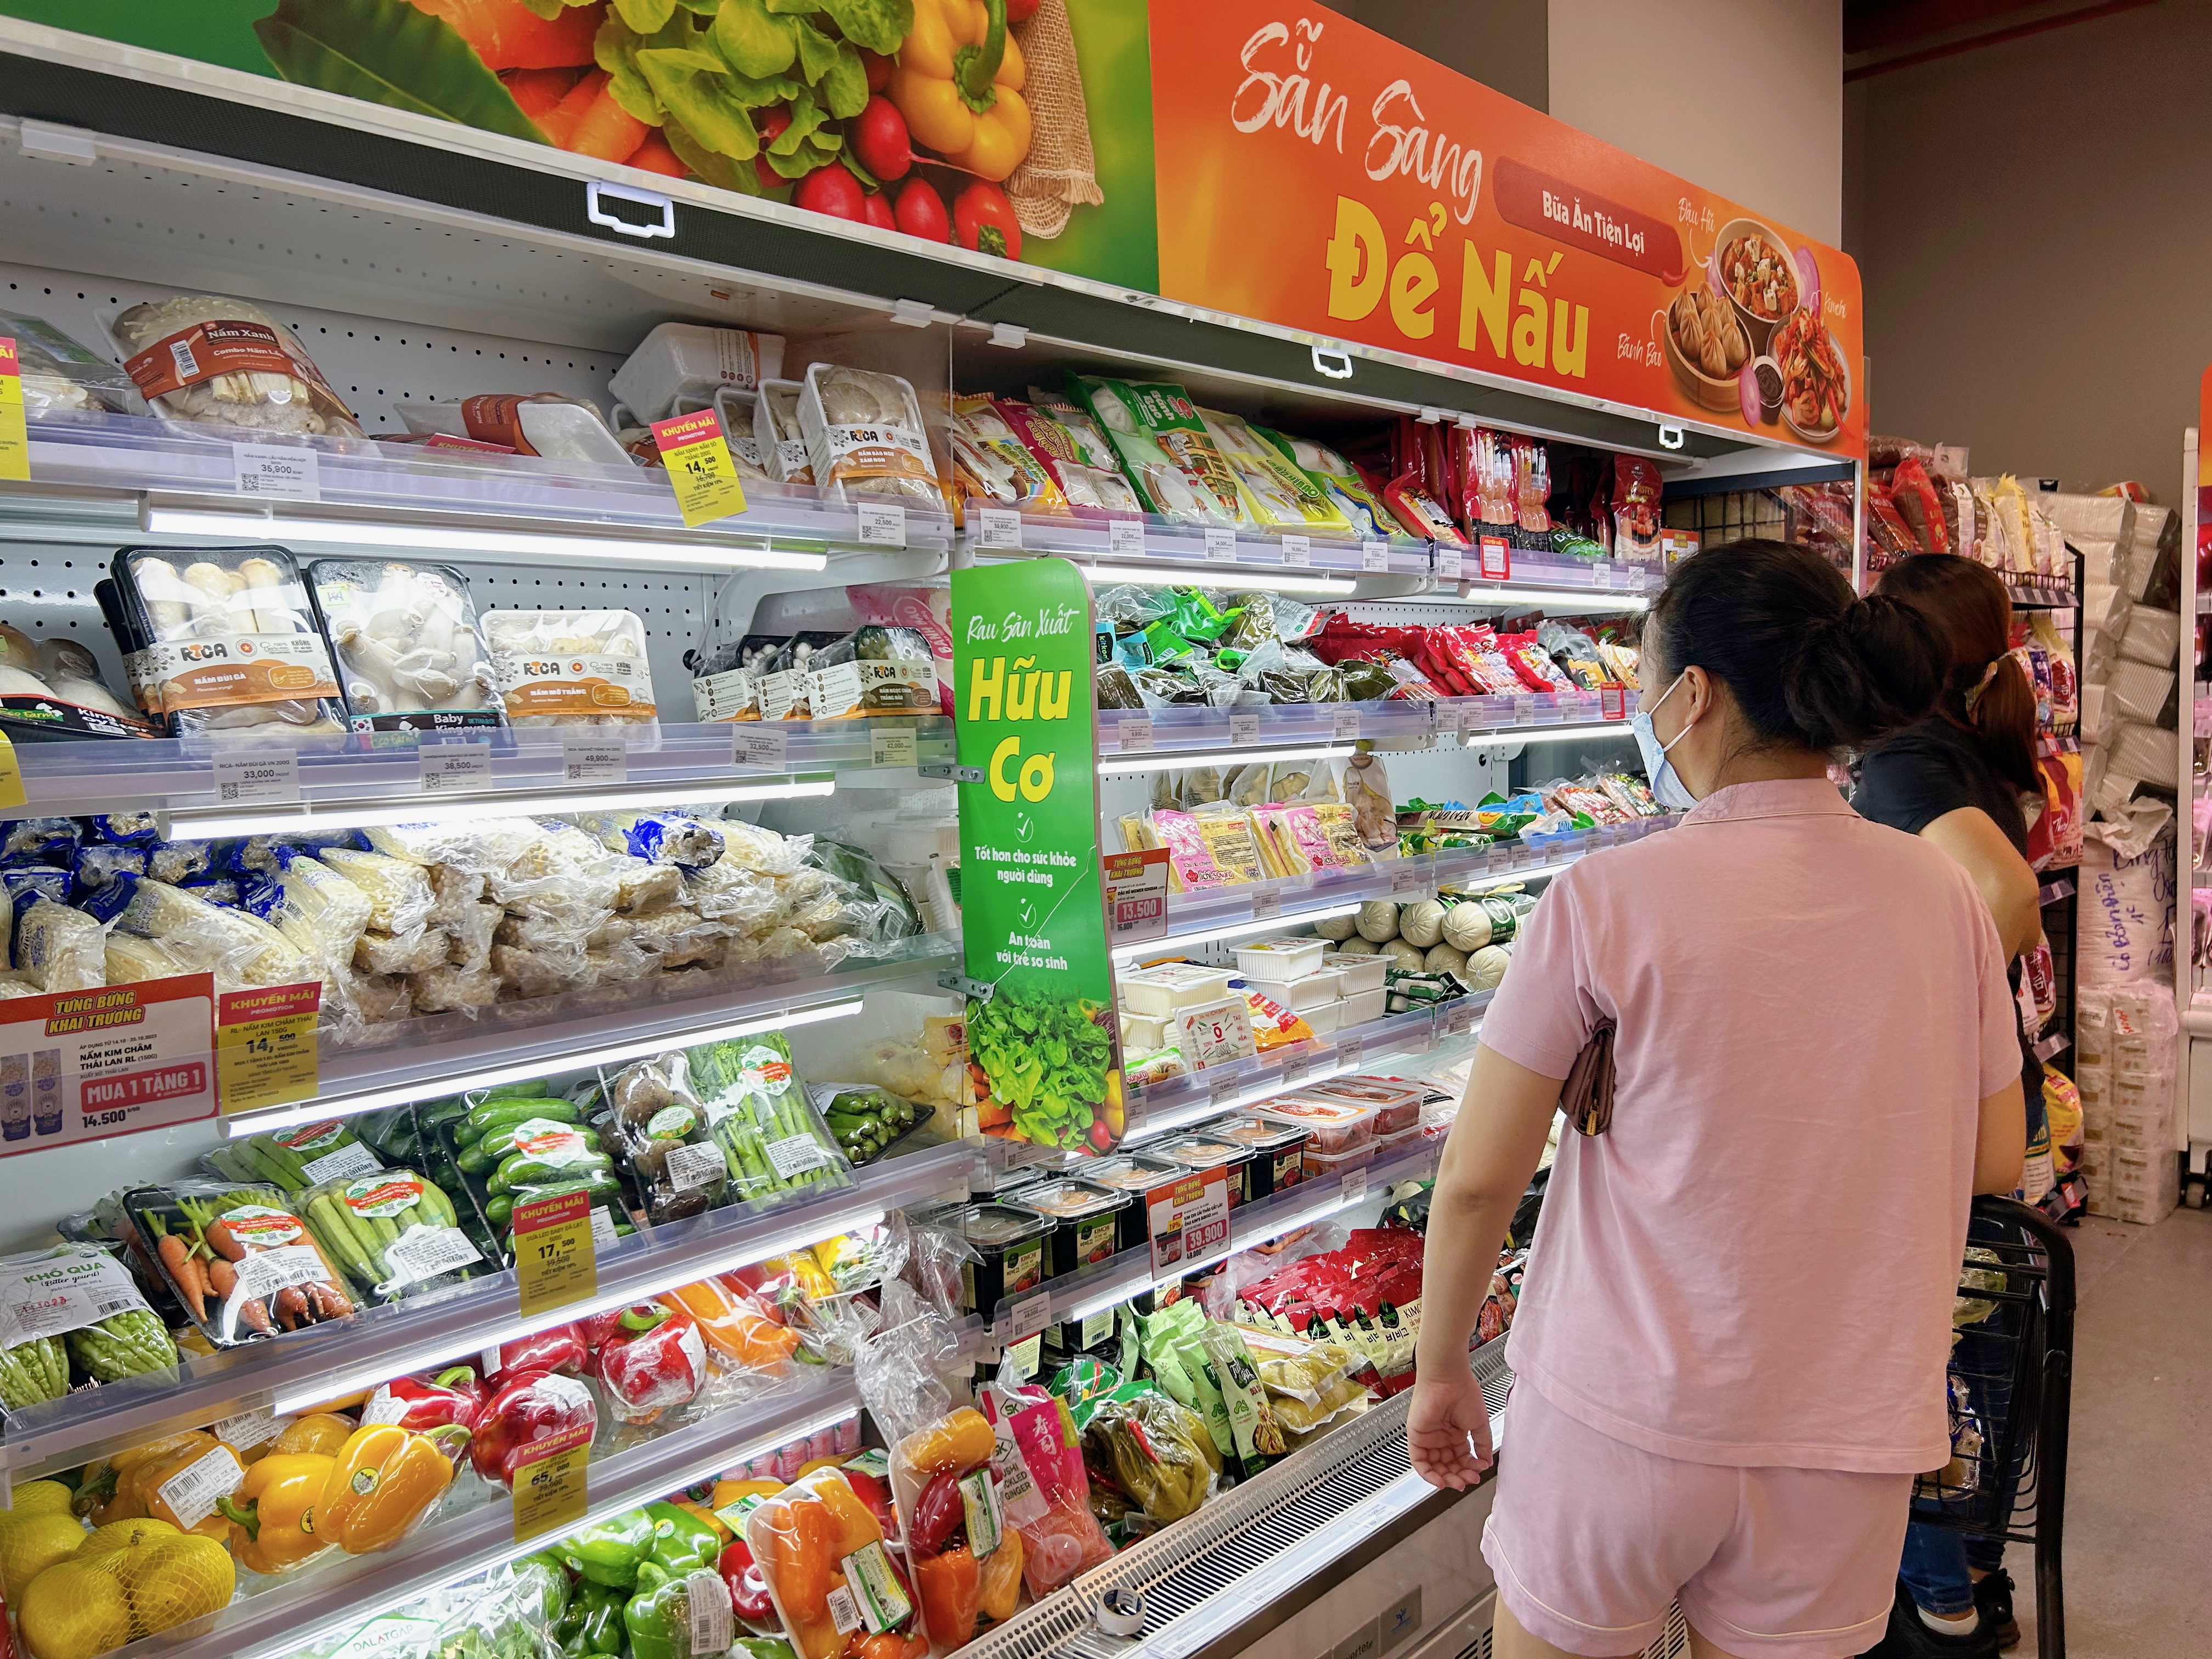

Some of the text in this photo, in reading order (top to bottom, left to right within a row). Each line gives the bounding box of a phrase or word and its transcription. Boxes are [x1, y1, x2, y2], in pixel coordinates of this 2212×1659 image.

[1232, 18, 1482, 224] Sẵn Sàng
[1542, 190, 1645, 255] Bữa Ăn Tiện Lợi
[1326, 194, 1589, 379] Để Nấu
[207, 328, 275, 342] Nấm Xanh
[1143, 396, 1163, 420] Bao
[1150, 390, 1175, 421] Bánh
[661, 416, 715, 437] KHUYẾN MÃI
[677, 430, 707, 442] PROMOTION
[849, 429, 879, 443] RICA
[261, 464, 292, 474] 35,900
[685, 456, 716, 475] 14, 500
[967, 602, 1080, 644] Rau Sản Xuất
[180, 642, 229, 662] RICA
[194, 671, 247, 685] NẤM ĐÙI GÀ
[523, 661, 561, 676] RICA
[873, 665, 896, 679] RICA
[530, 688, 550, 697] NẤM
[561, 686, 587, 696] TRẮNG
[968, 654, 1073, 723] Hữu
[433, 713, 464, 725] Baby
[444, 761, 471, 770] 38,500
[585, 755, 609, 763] 49,900
[244, 769, 274, 780] 33,000
[989, 735, 1057, 804] Cơ
[974, 844, 1076, 867] Tốt hơn cho sức khỏe
[997, 867, 1053, 888] người dùng
[1110, 870, 1124, 880] KHAI
[1122, 899, 1158, 921] 13.500
[1008, 931, 1051, 950] An toàn
[996, 949, 1068, 970] với trẻ sơ sinh
[55, 991, 136, 1015] TƯNG BỪNG
[230, 990, 315, 1010] KHUYẾN MÃI
[250, 1004, 295, 1015] PROMOTION
[47, 1008, 144, 1035] KHAI TRƯƠNG
[243, 1024, 259, 1032] NẤM
[275, 1017, 296, 1026] CHÂM
[80, 1043, 153, 1061] NẤM KIM CHÂM
[246, 1032, 296, 1054] 14, 500
[80, 1059, 104, 1070] THÁI
[105, 1057, 123, 1066] LAN
[80, 1071, 94, 1080] XUẤT
[87, 1081, 127, 1104] MUA
[129, 1080, 138, 1096] 1
[143, 1070, 189, 1098] TẶNG
[193, 1068, 201, 1085] 1
[82, 1109, 127, 1128] 14.500
[654, 1108, 687, 1125] DALATGAP
[521, 1195, 585, 1221] KHUYẾN MÃI
[537, 1210, 571, 1224] PROMOTION
[1094, 1224, 1111, 1235] KIMCHI
[1189, 1221, 1223, 1249] 39.900
[538, 1238, 575, 1259] 17, 500
[1020, 1250, 1037, 1262] KIMCHI
[23, 1261, 106, 1283] KHỔ QUA
[41, 1270, 100, 1287] (Bitter gourd)
[1385, 1327, 1410, 1342] 비비고
[1004, 1404, 1019, 1415] SK
[523, 1426, 589, 1456] KHUYẾN MÃI
[531, 1462, 571, 1487] 65, 000
[1004, 1481, 1032, 1501] GINGER
[351, 1624, 415, 1654] DALATGAP
